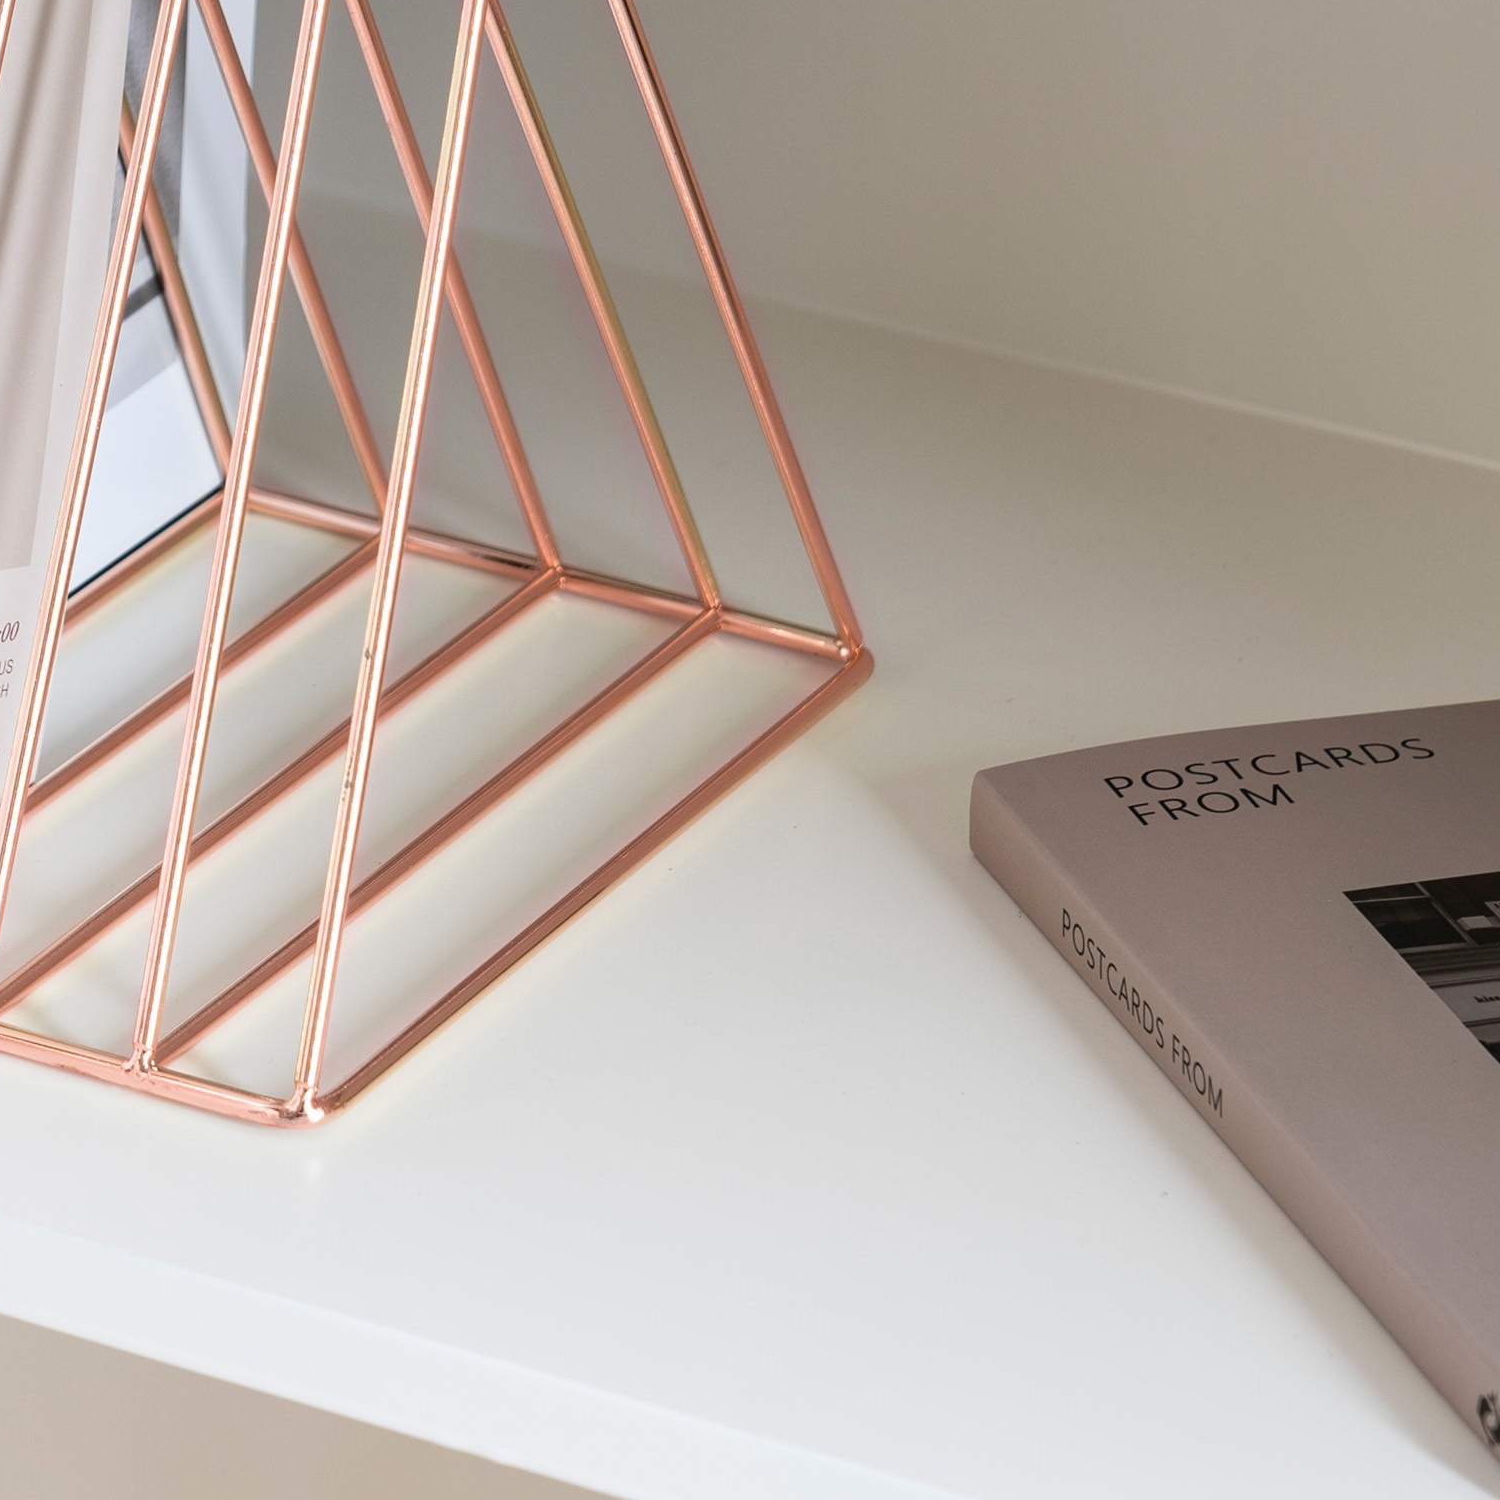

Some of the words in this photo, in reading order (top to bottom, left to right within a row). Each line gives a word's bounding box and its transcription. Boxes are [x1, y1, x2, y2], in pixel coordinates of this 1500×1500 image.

[1103, 738, 1435, 799] POSTCARDS
[1127, 783, 1295, 826] FROM
[1062, 908, 1164, 1049] POSTCARDS
[1172, 1033, 1223, 1118] FROM
